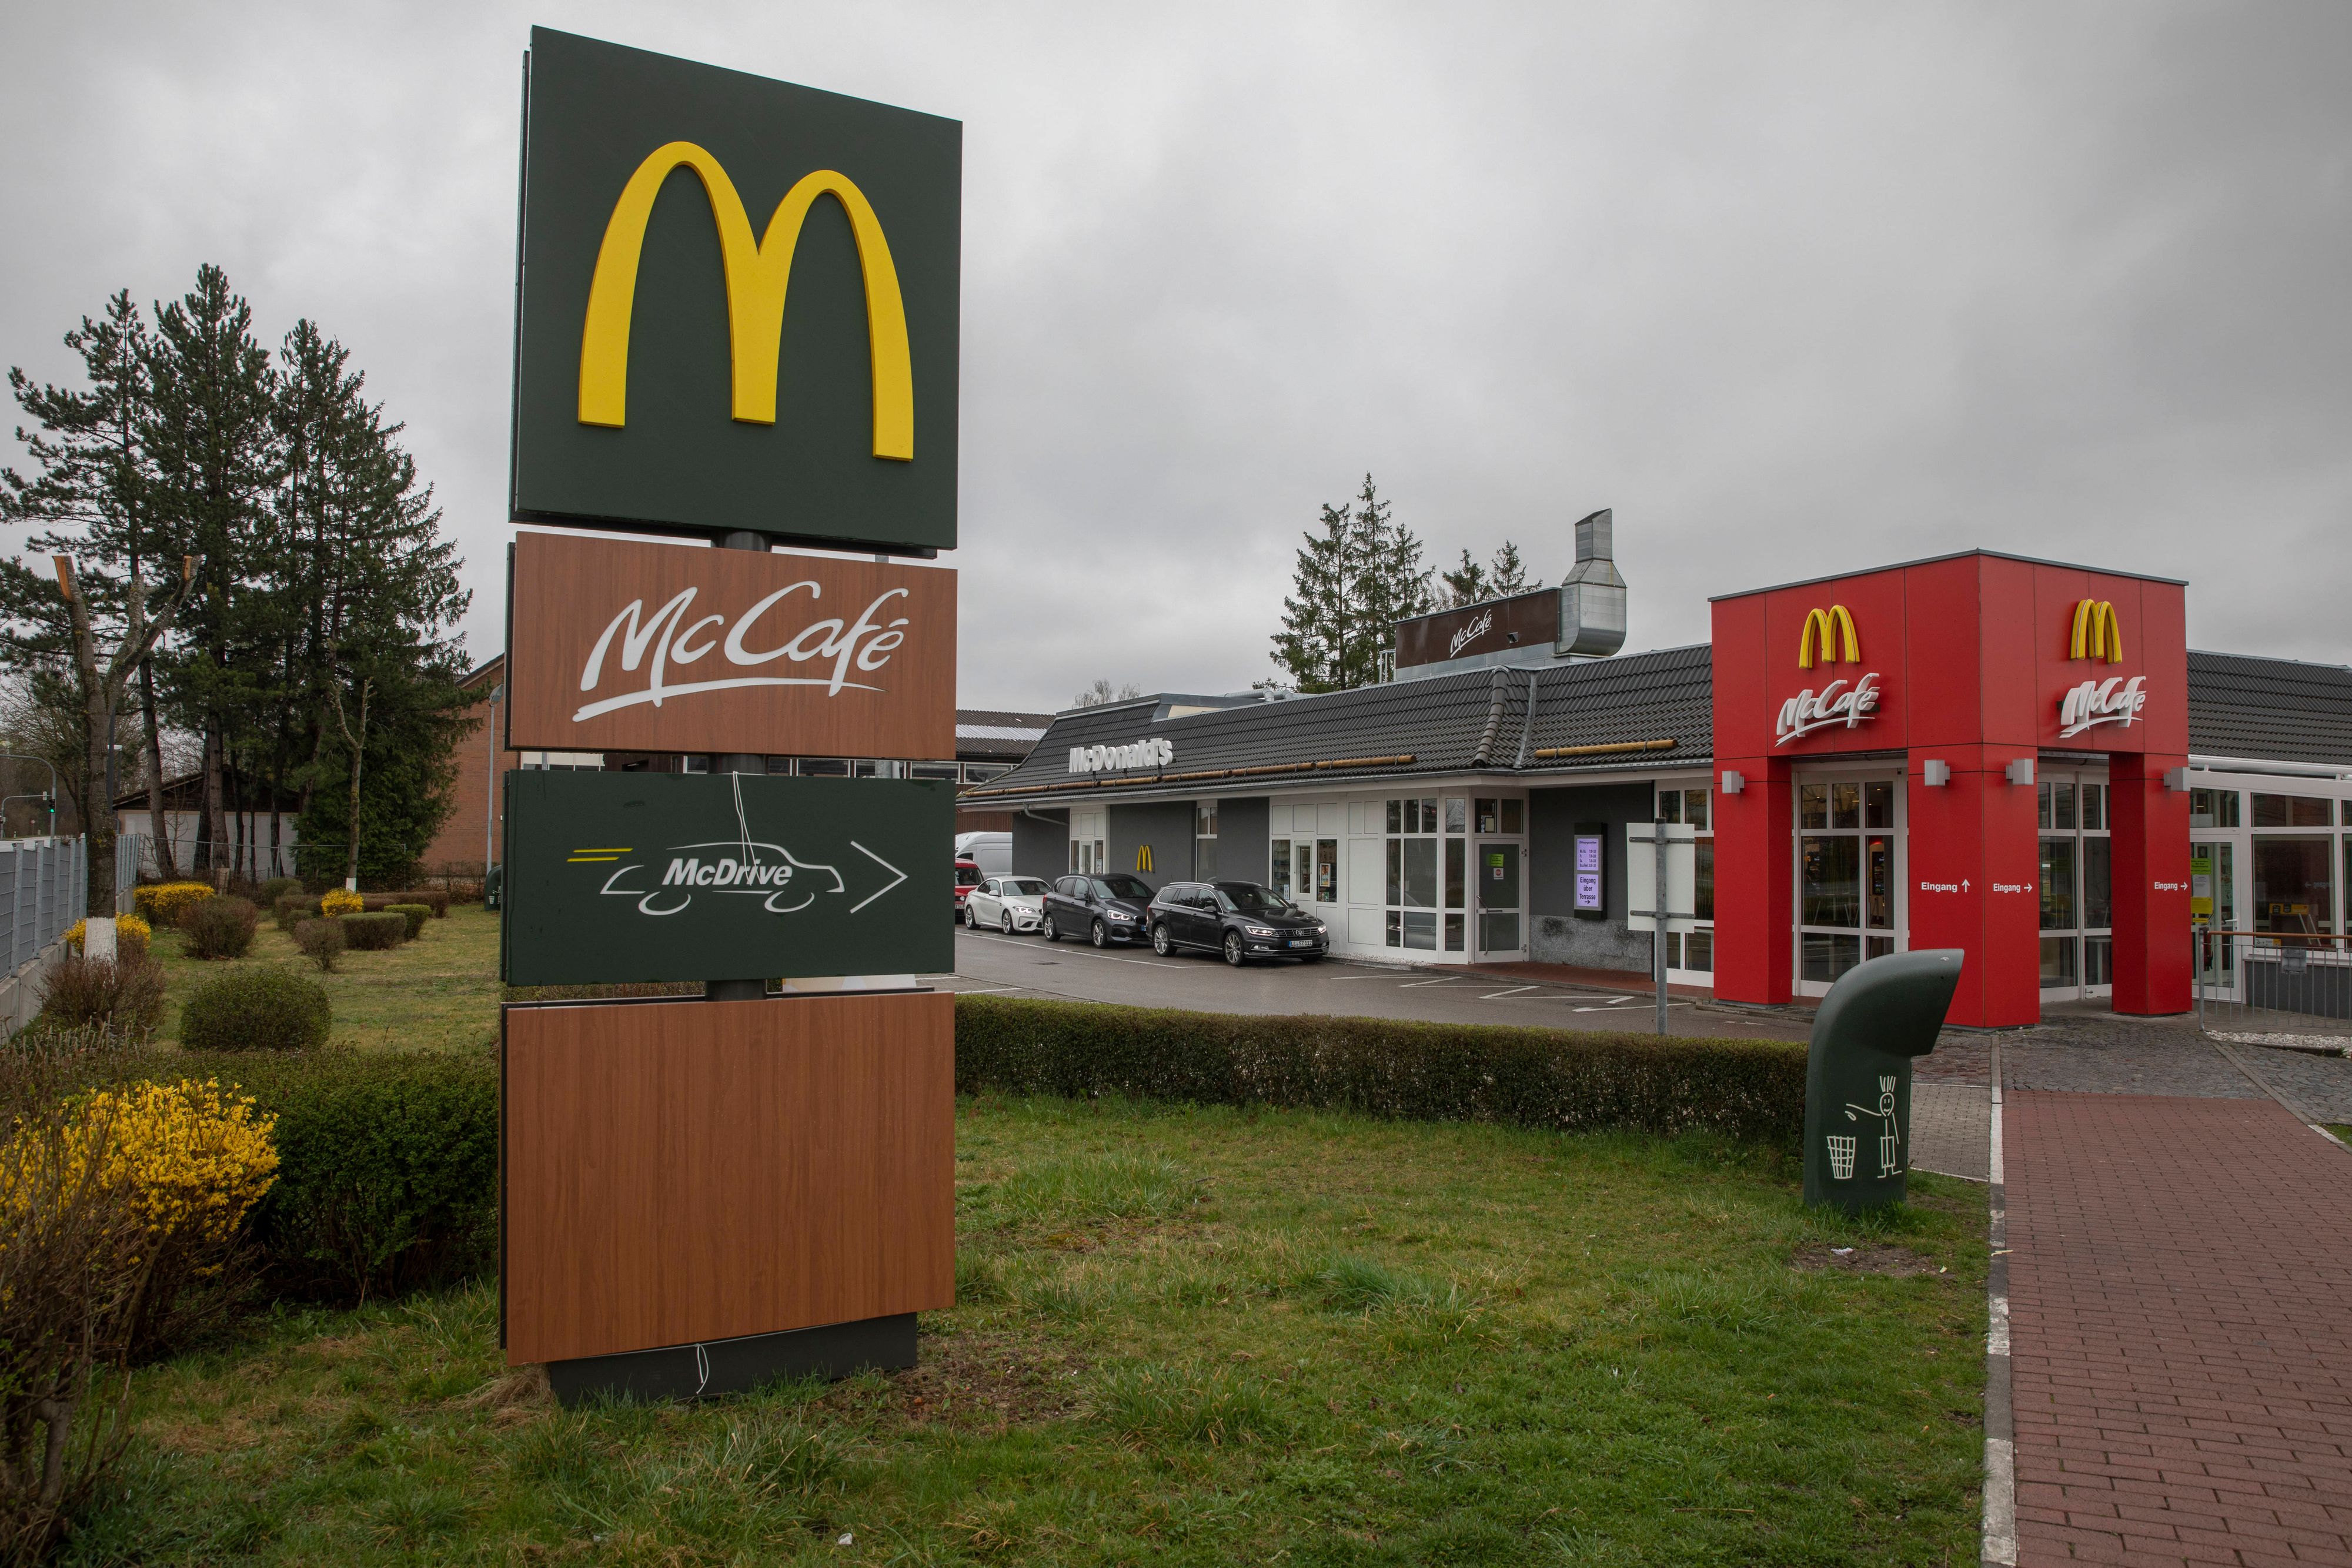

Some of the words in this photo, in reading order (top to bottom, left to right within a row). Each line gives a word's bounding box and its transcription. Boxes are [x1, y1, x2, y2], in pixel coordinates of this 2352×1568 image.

[579, 580, 909, 708] McCafé
[1450, 609, 1492, 654] McCafé
[1776, 673, 1880, 737] McCafé
[2060, 676, 2146, 730] McCafé
[1068, 737, 1173, 773] McDonald's
[662, 858, 793, 885] McDrive
[1921, 882, 1957, 892] Eingang
[1993, 883, 2020, 893] Eingang
[2154, 882, 2178, 891] Eingang
